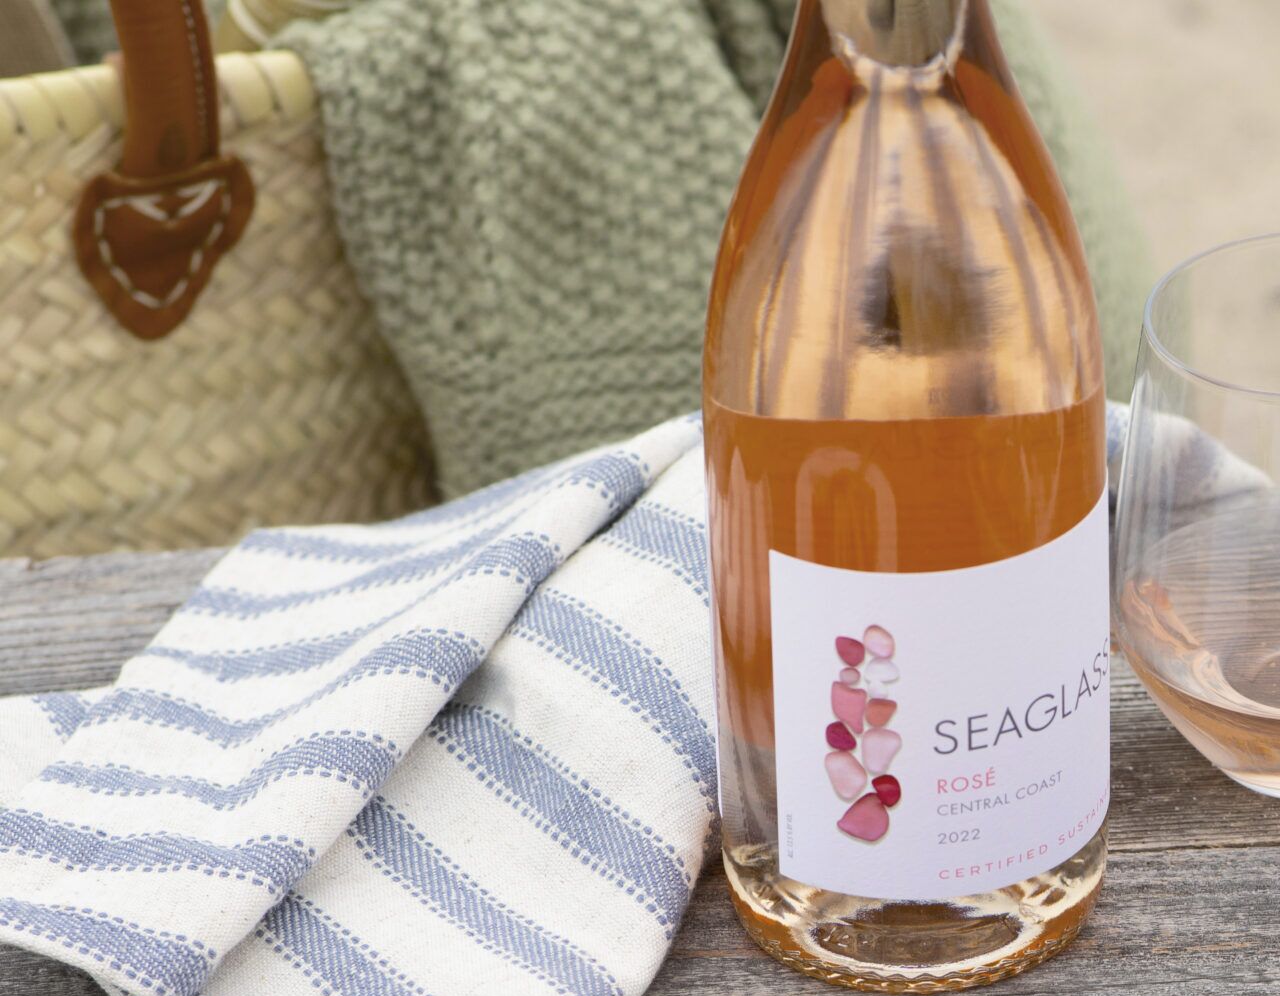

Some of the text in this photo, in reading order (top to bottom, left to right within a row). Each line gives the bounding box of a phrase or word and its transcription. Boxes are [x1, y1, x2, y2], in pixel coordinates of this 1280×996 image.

[937, 767, 996, 794] ROSÉ
[937, 770, 1063, 816] CENTRAL COAST
[938, 828, 981, 845] 2022
[938, 844, 1048, 880] CERTIFIED
